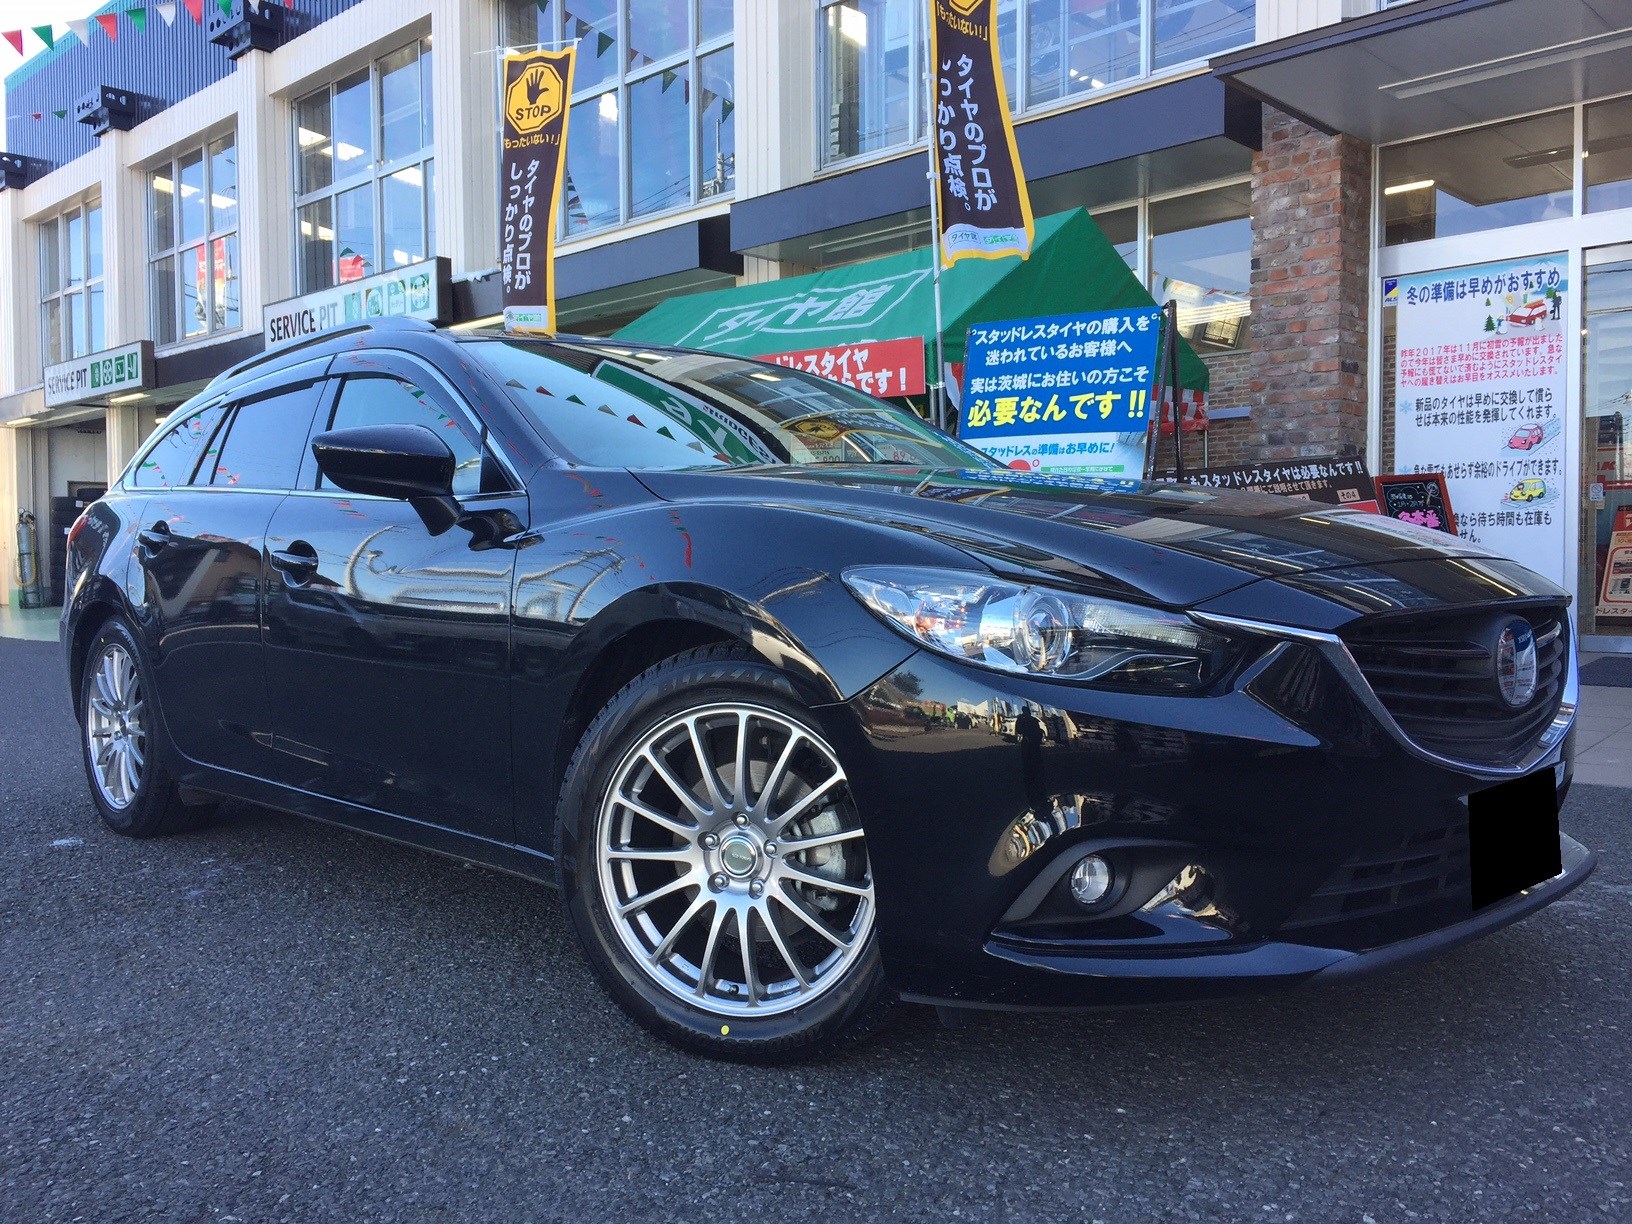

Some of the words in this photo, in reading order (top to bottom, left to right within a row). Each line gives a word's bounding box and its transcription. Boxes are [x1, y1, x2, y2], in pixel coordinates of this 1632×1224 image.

[515, 104, 552, 121] STOP
[504, 133, 560, 149] もったいない！」
[957, 53, 998, 211] タイヤのプロが
[502, 162, 523, 294] しっかり点検。
[514, 159, 540, 290] タイヤのプロが
[1406, 266, 1560, 306] 冬の準備は早めがおすすめ
[270, 308, 316, 342] SERVICE
[319, 302, 338, 330] PIT
[703, 284, 895, 342] タイヤ館
[974, 315, 1150, 346] スタッドレスタイヤの購入を
[985, 339, 1133, 367] 迷われているお客様へ
[76, 368, 87, 389] PIT
[828, 367, 907, 394] らです！
[970, 366, 1150, 394] 実は茨城にお住いの方こそ
[1415, 387, 1553, 412] 新品のタイヤは早めに交換して慣ら
[1415, 404, 1557, 428] せば本来の性能を発揮してくれます。
